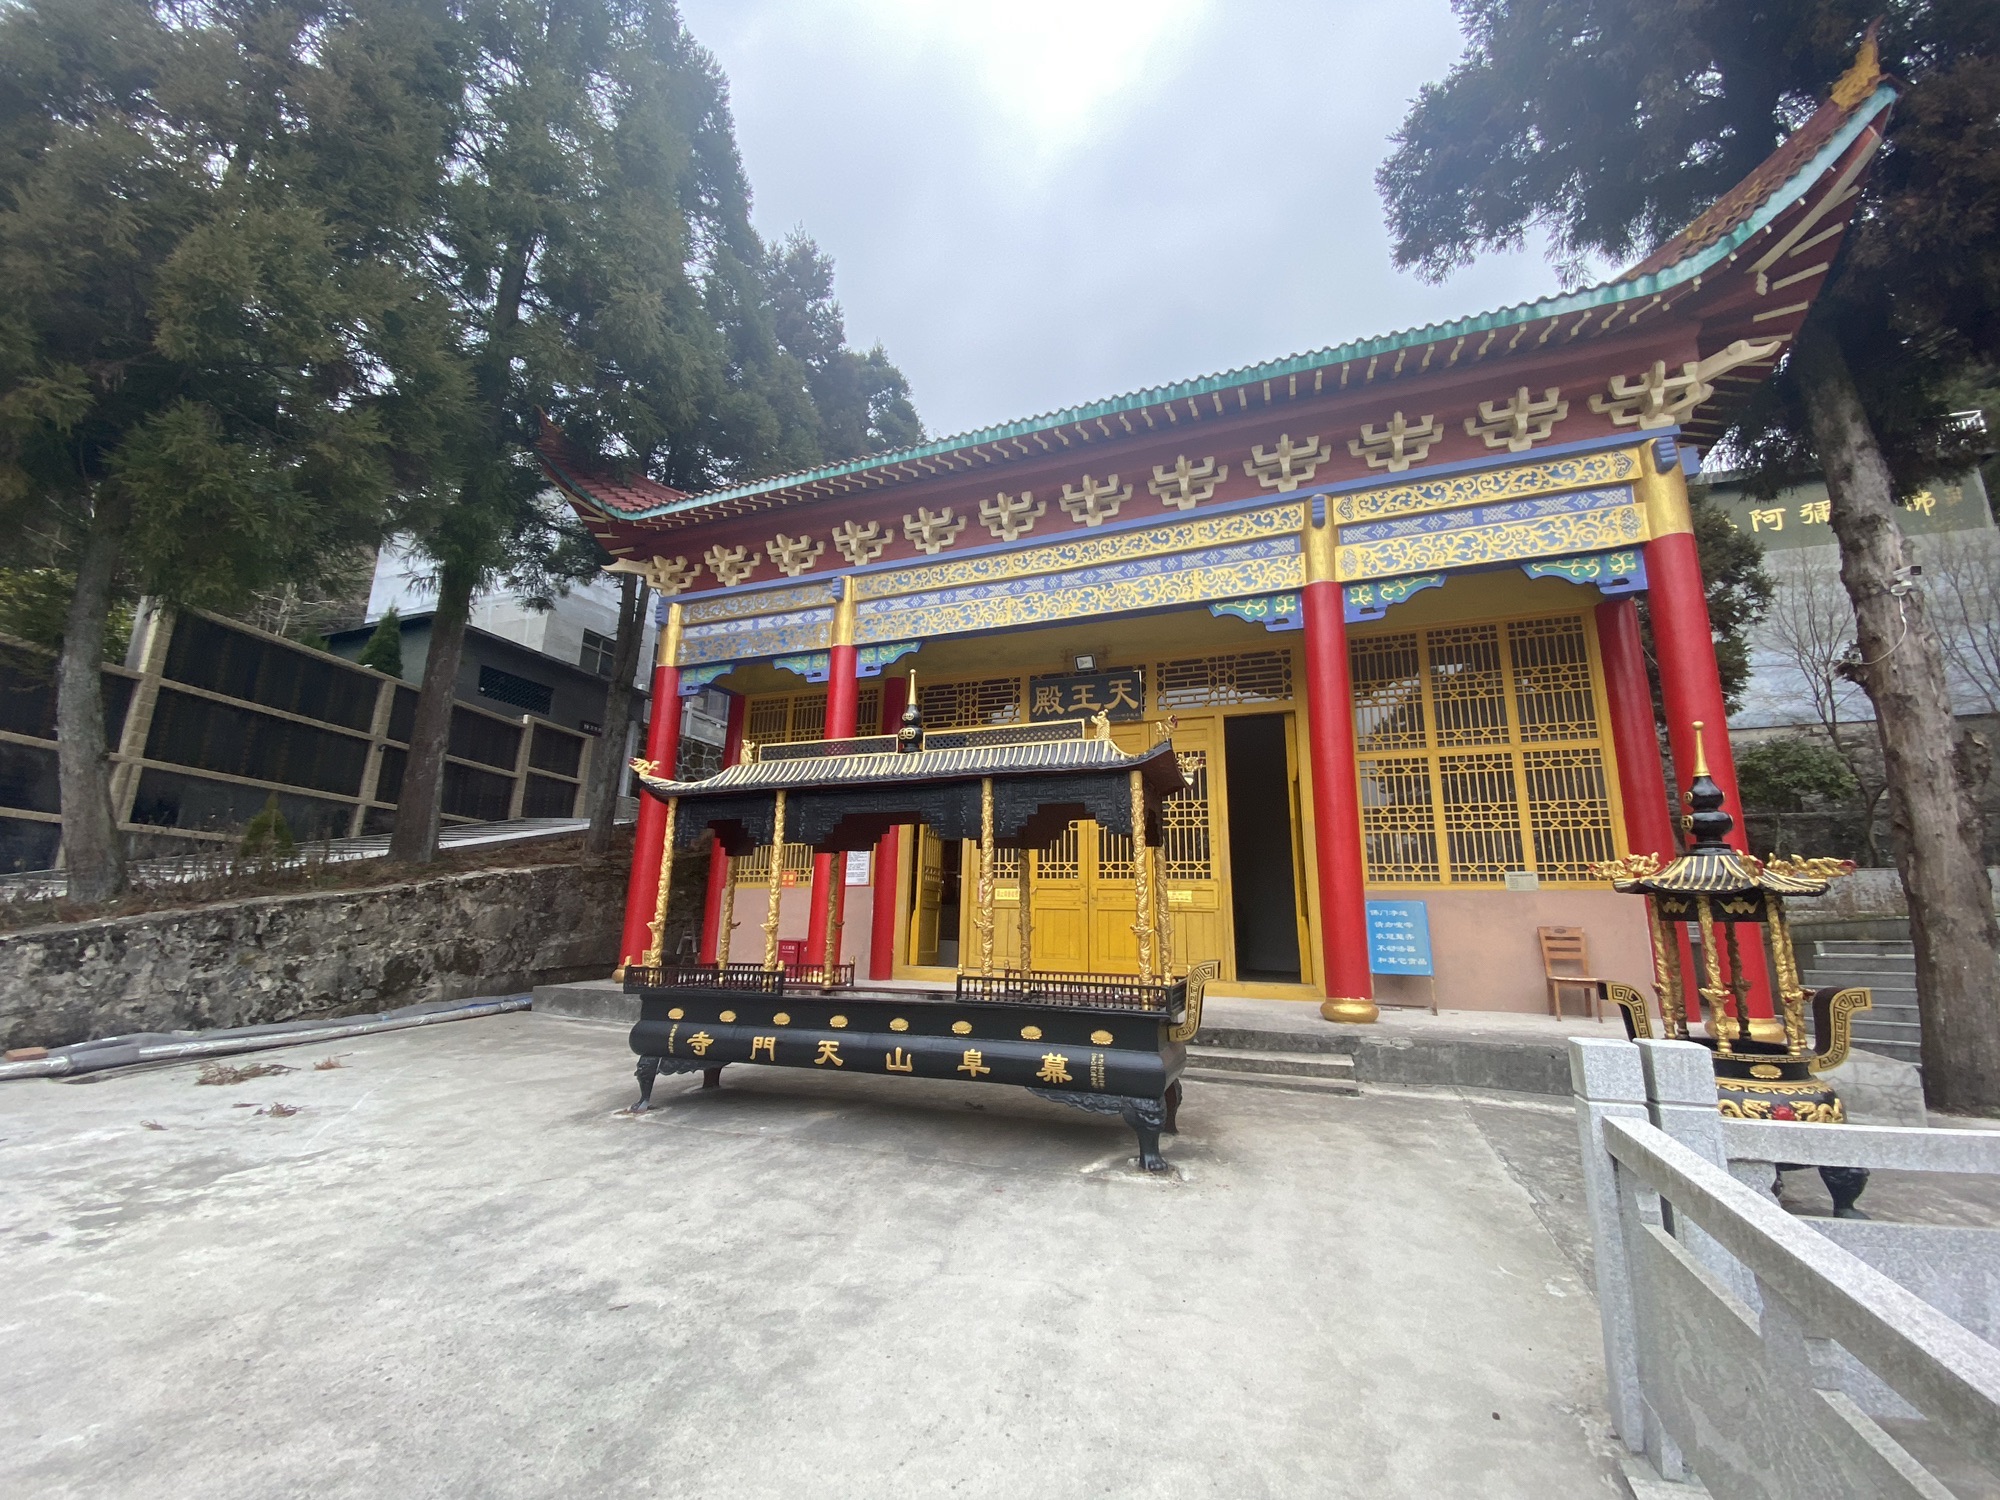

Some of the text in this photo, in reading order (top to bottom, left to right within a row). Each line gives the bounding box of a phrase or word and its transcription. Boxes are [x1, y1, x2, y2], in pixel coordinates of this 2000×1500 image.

[1032, 679, 1139, 716] 天王殿
[686, 1031, 1073, 1084] 幕阜山天門寺
